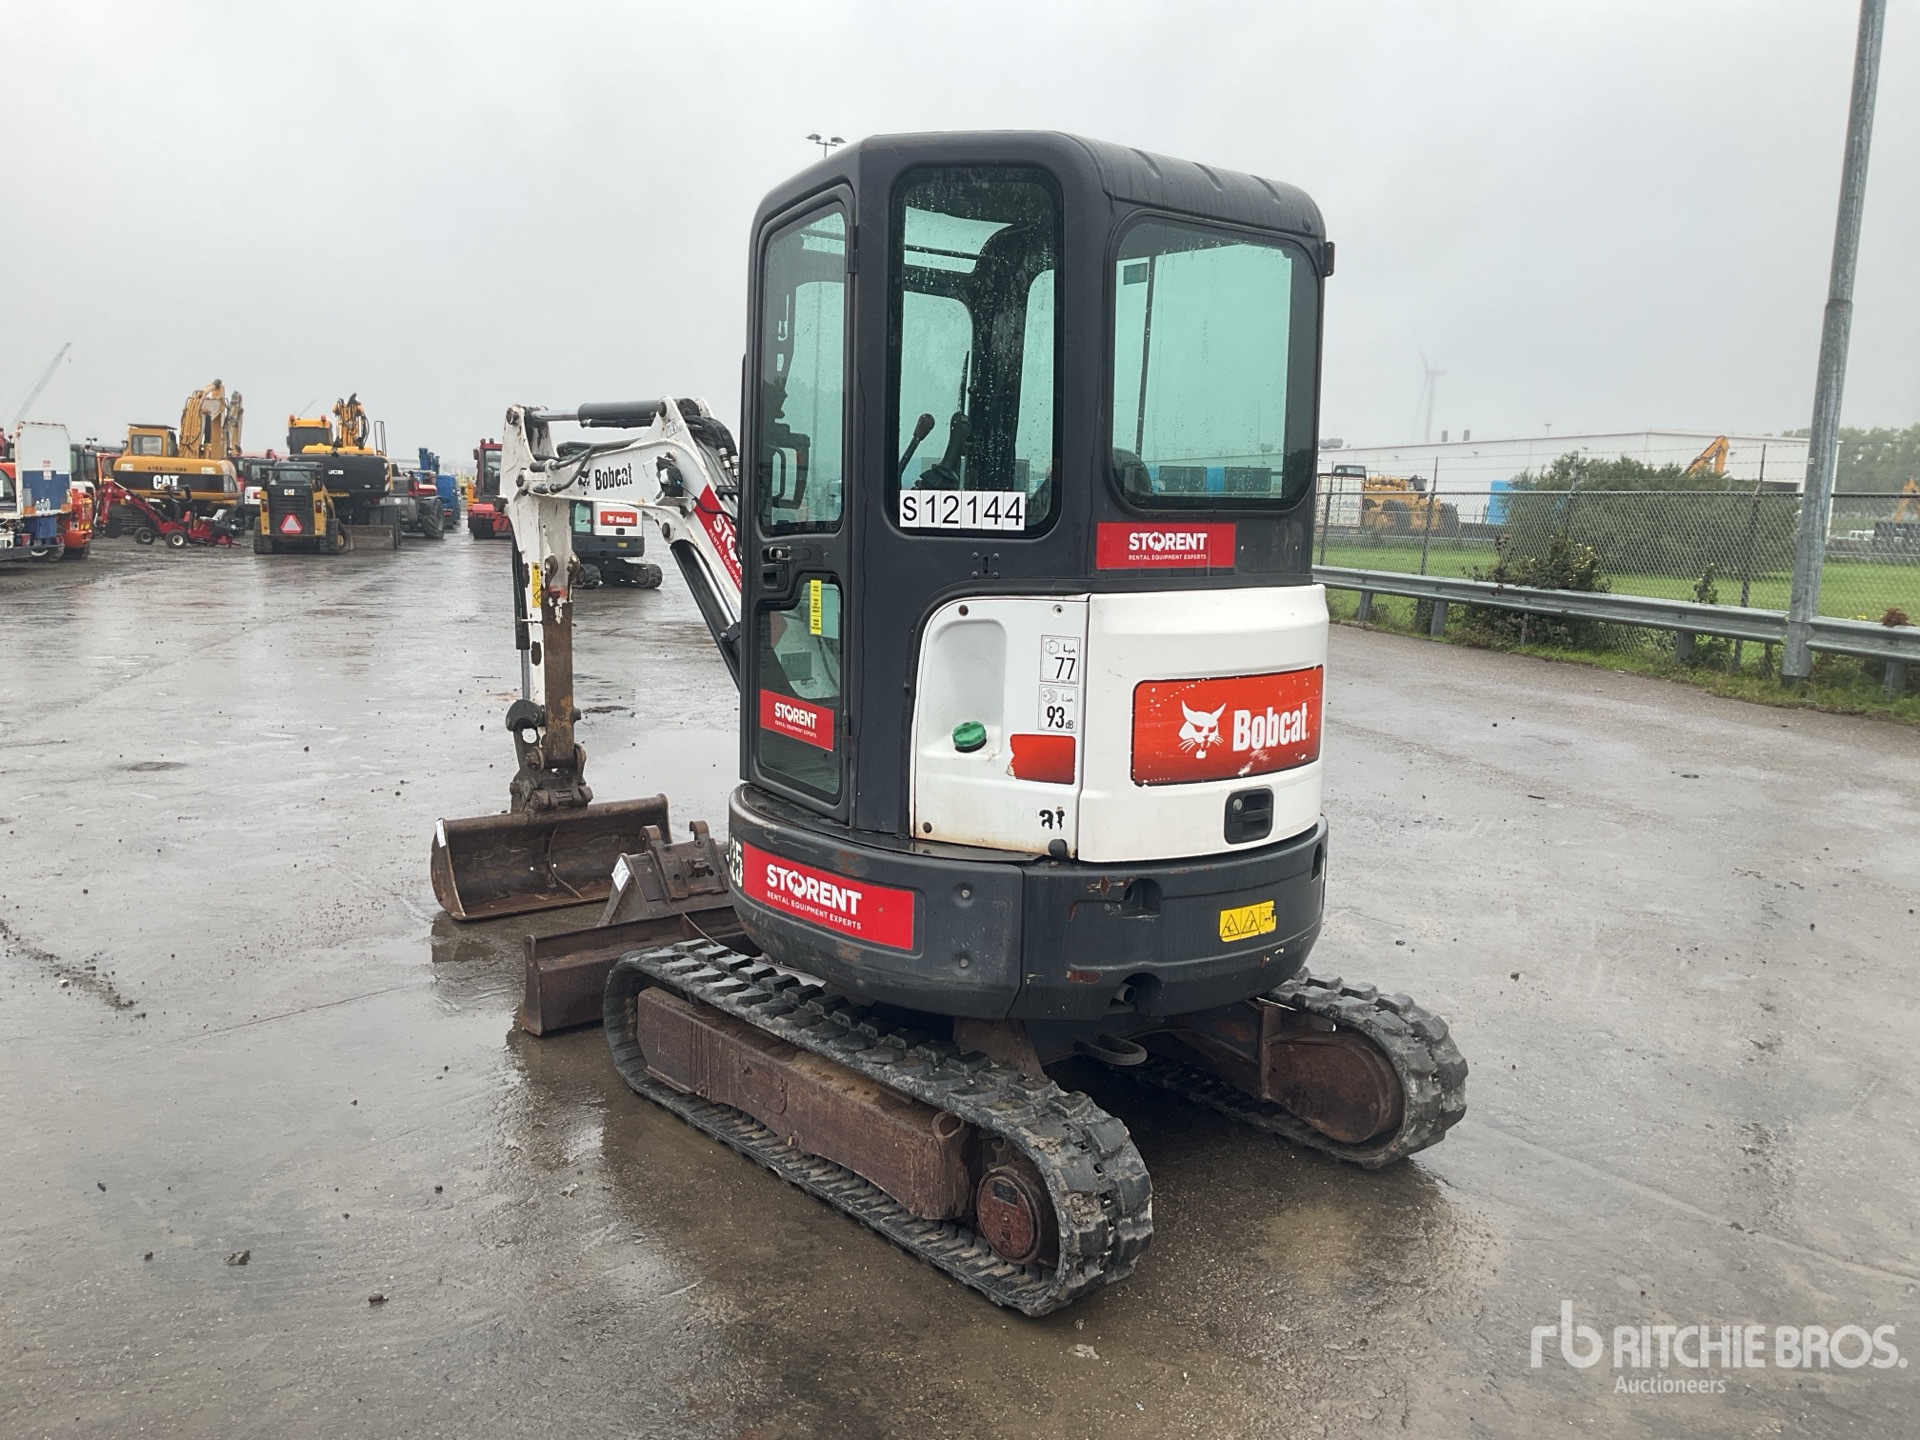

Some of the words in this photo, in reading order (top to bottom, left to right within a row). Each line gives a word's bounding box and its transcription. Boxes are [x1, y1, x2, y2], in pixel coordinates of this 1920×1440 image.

[152, 474, 180, 490] CAT
[594, 462, 633, 490] Bobcat
[902, 494, 1023, 526] S12144
[1128, 531, 1208, 551] STORENT
[1054, 656, 1076, 680] 77
[774, 702, 817, 729] STORENT
[1232, 702, 1308, 751] Bobcat
[766, 864, 862, 915] STORENT
[767, 891, 790, 905] RENTAL
[791, 902, 828, 920] EQUIPMENT
[829, 914, 862, 930] EXPERTS
